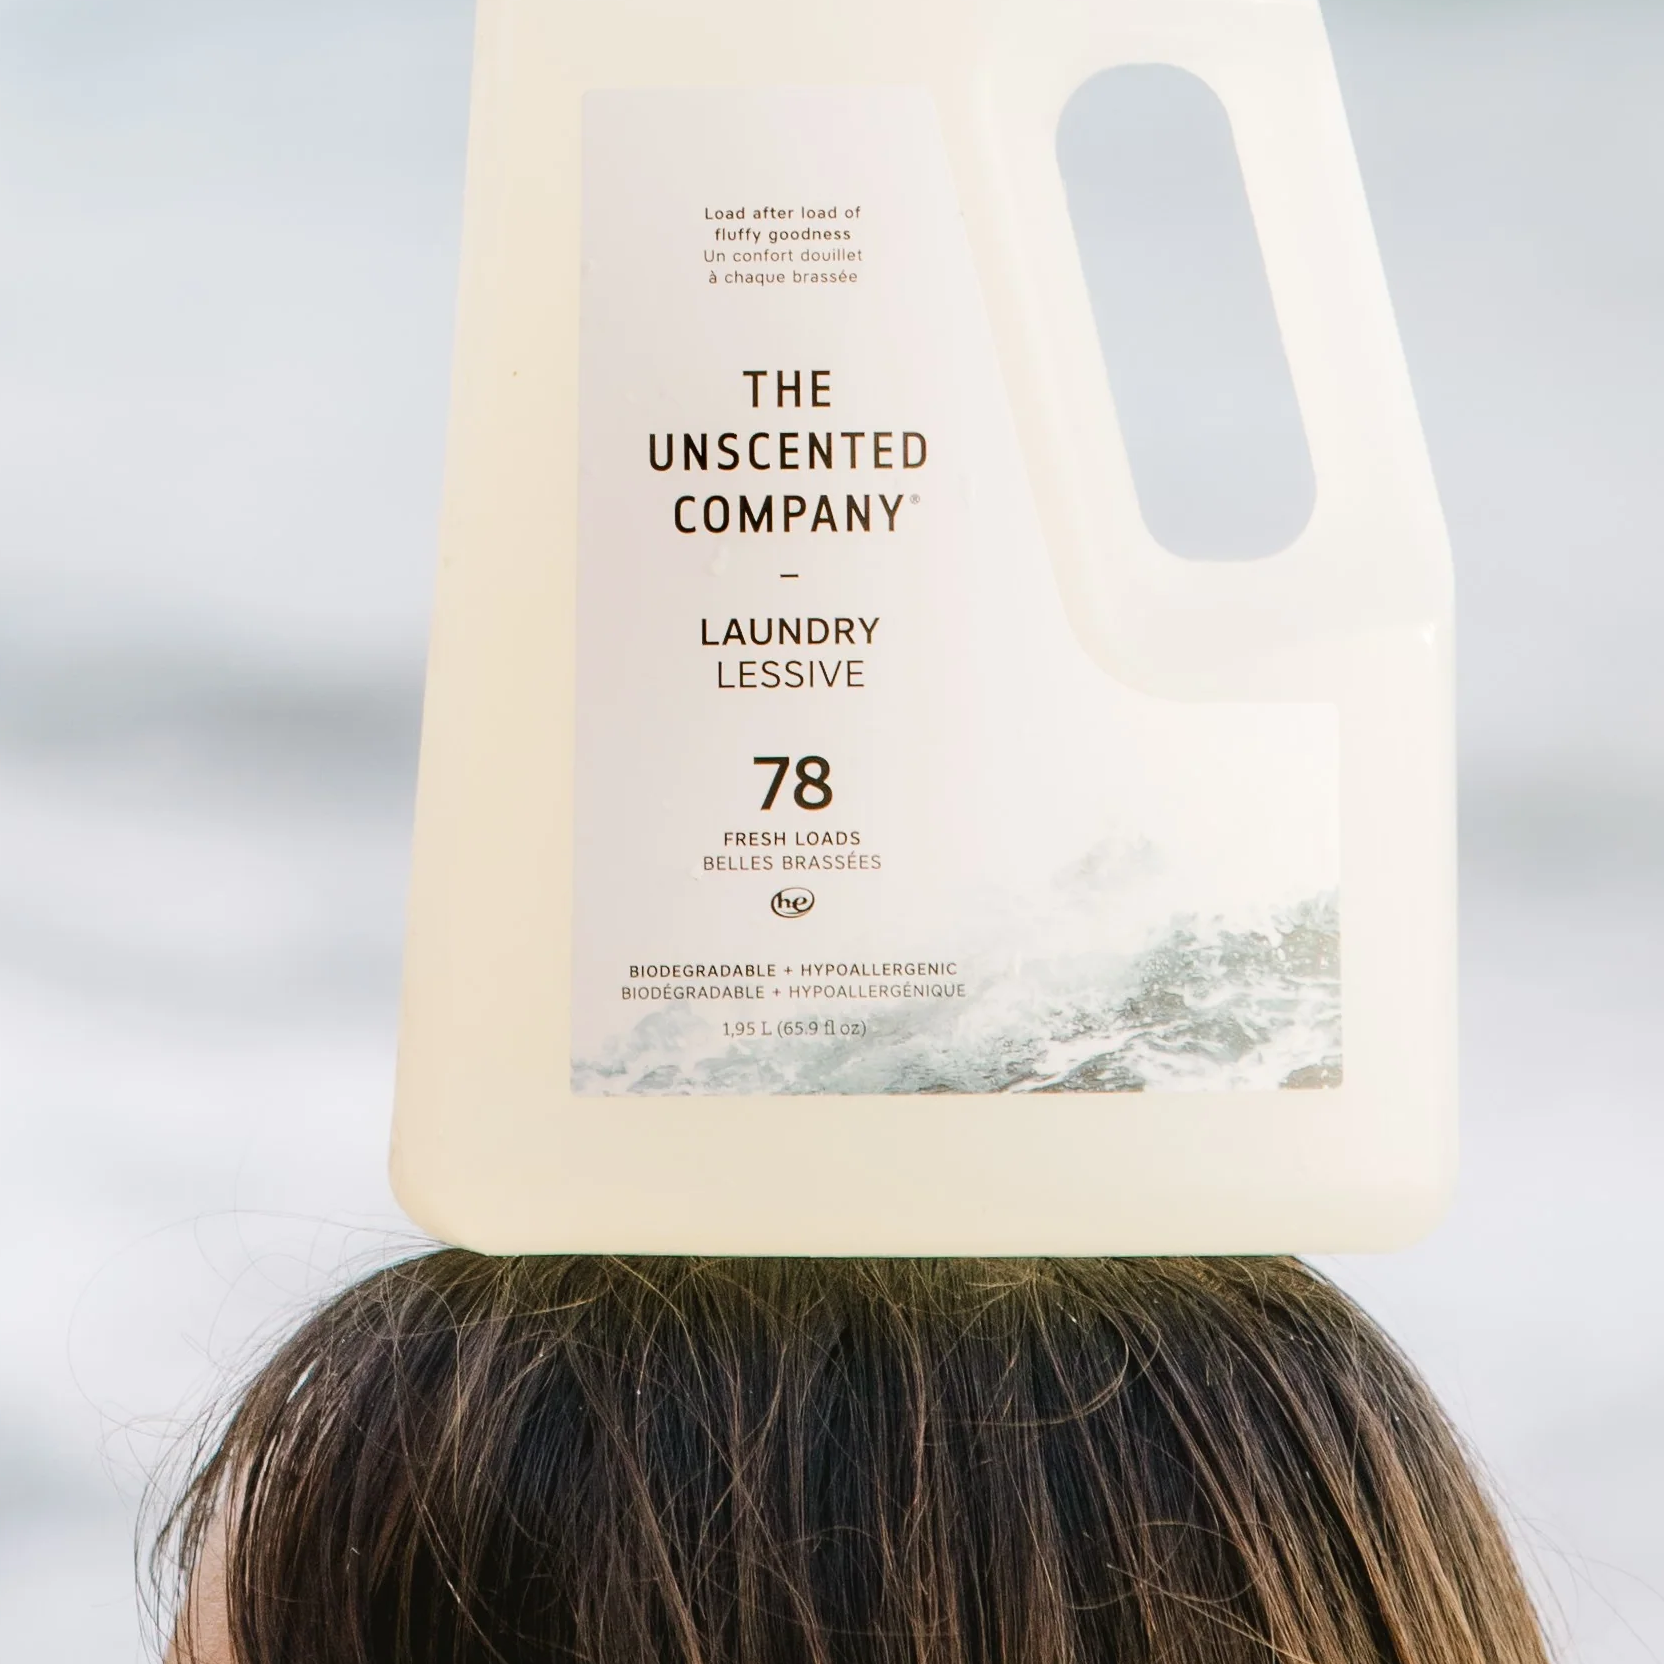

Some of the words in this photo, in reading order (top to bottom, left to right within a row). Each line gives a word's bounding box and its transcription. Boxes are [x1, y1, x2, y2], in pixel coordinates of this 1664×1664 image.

[705, 206, 745, 220] Load
[752, 206, 794, 220] after
[801, 206, 837, 219] load
[844, 205, 861, 219] of
[715, 227, 761, 244] fluffy
[768, 227, 851, 244] goodness
[703, 249, 726, 263] Un
[732, 248, 794, 263] confort
[800, 248, 862, 262] douillet
[708, 269, 718, 284] à
[724, 270, 786, 287] chaque
[792, 269, 858, 284] brassée
[742, 370, 831, 408] THE
[649, 431, 927, 472] UNSCENTED
[701, 617, 880, 646] LAUNDRY
[717, 660, 865, 689] LESSIVE
[753, 755, 833, 811] 78
[724, 831, 786, 847] FRESH
[795, 831, 861, 846] LOADS
[703, 855, 774, 871] BELLES
[782, 850, 882, 871] BRASSÉES
[777, 892, 808, 910] he
[629, 964, 776, 978] BIODEGRADABLE
[801, 962, 957, 977] HYPOALLERGENIC
[621, 983, 765, 1000] BIODÉGRADABLE
[789, 981, 966, 999] HYPOALLERGÉNIQUE
[723, 1021, 756, 1038] 1,95
[760, 1020, 773, 1036] L
[777, 1020, 819, 1039] (65.9
